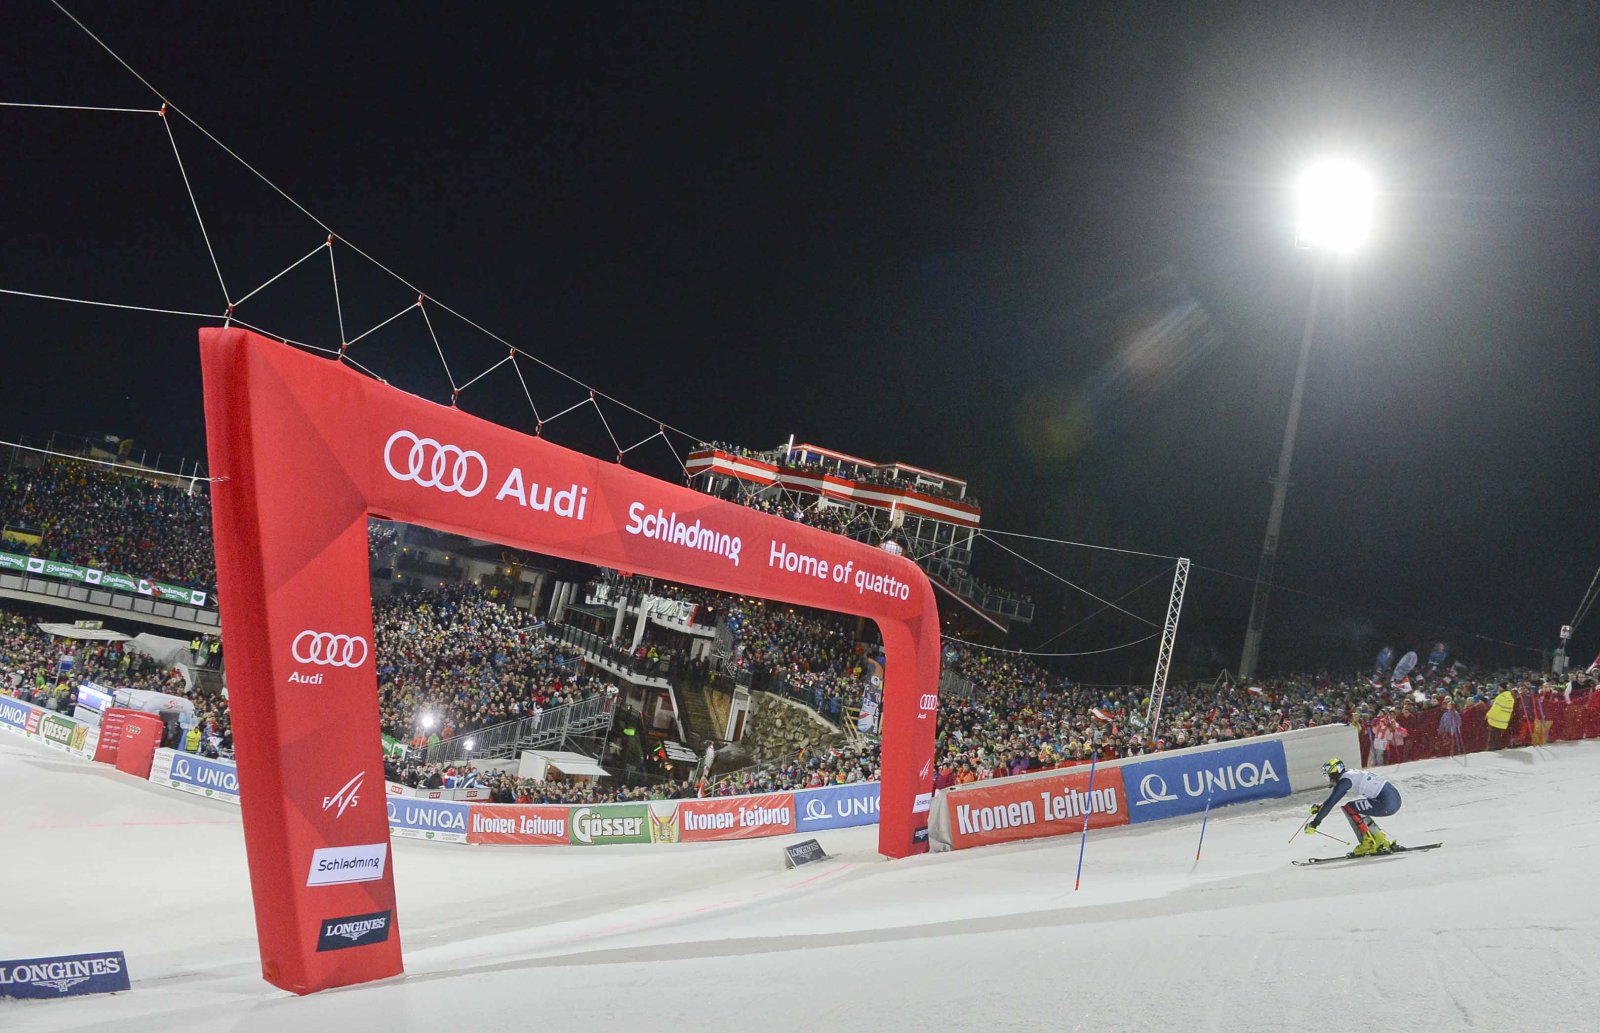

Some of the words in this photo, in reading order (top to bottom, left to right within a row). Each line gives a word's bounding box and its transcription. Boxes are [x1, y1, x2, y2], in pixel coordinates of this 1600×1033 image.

[496, 468, 588, 520] Audi
[626, 502, 742, 566] Schladming
[769, 541, 829, 579] Home
[833, 561, 854, 584] of
[855, 570, 910, 601] quattro
[288, 672, 323, 684] Audi
[0, 703, 27, 726] UNIQA
[391, 786, 403, 794] ORF
[1182, 759, 1280, 797] UNIQA
[684, 810, 734, 830] Kronen
[739, 805, 790, 826] Zeitung
[956, 800, 1036, 835] Kronen
[1041, 787, 1118, 821] Zeitung
[1355, 800, 1373, 811] ITA
[406, 807, 465, 829] UNIQA
[472, 813, 516, 834] Kronen
[520, 815, 565, 836] Zeitung
[573, 808, 643, 843] Gösser
[317, 857, 380, 872] Schladming
[326, 917, 387, 937] LONGINES
[0, 957, 121, 984] LONGINES
